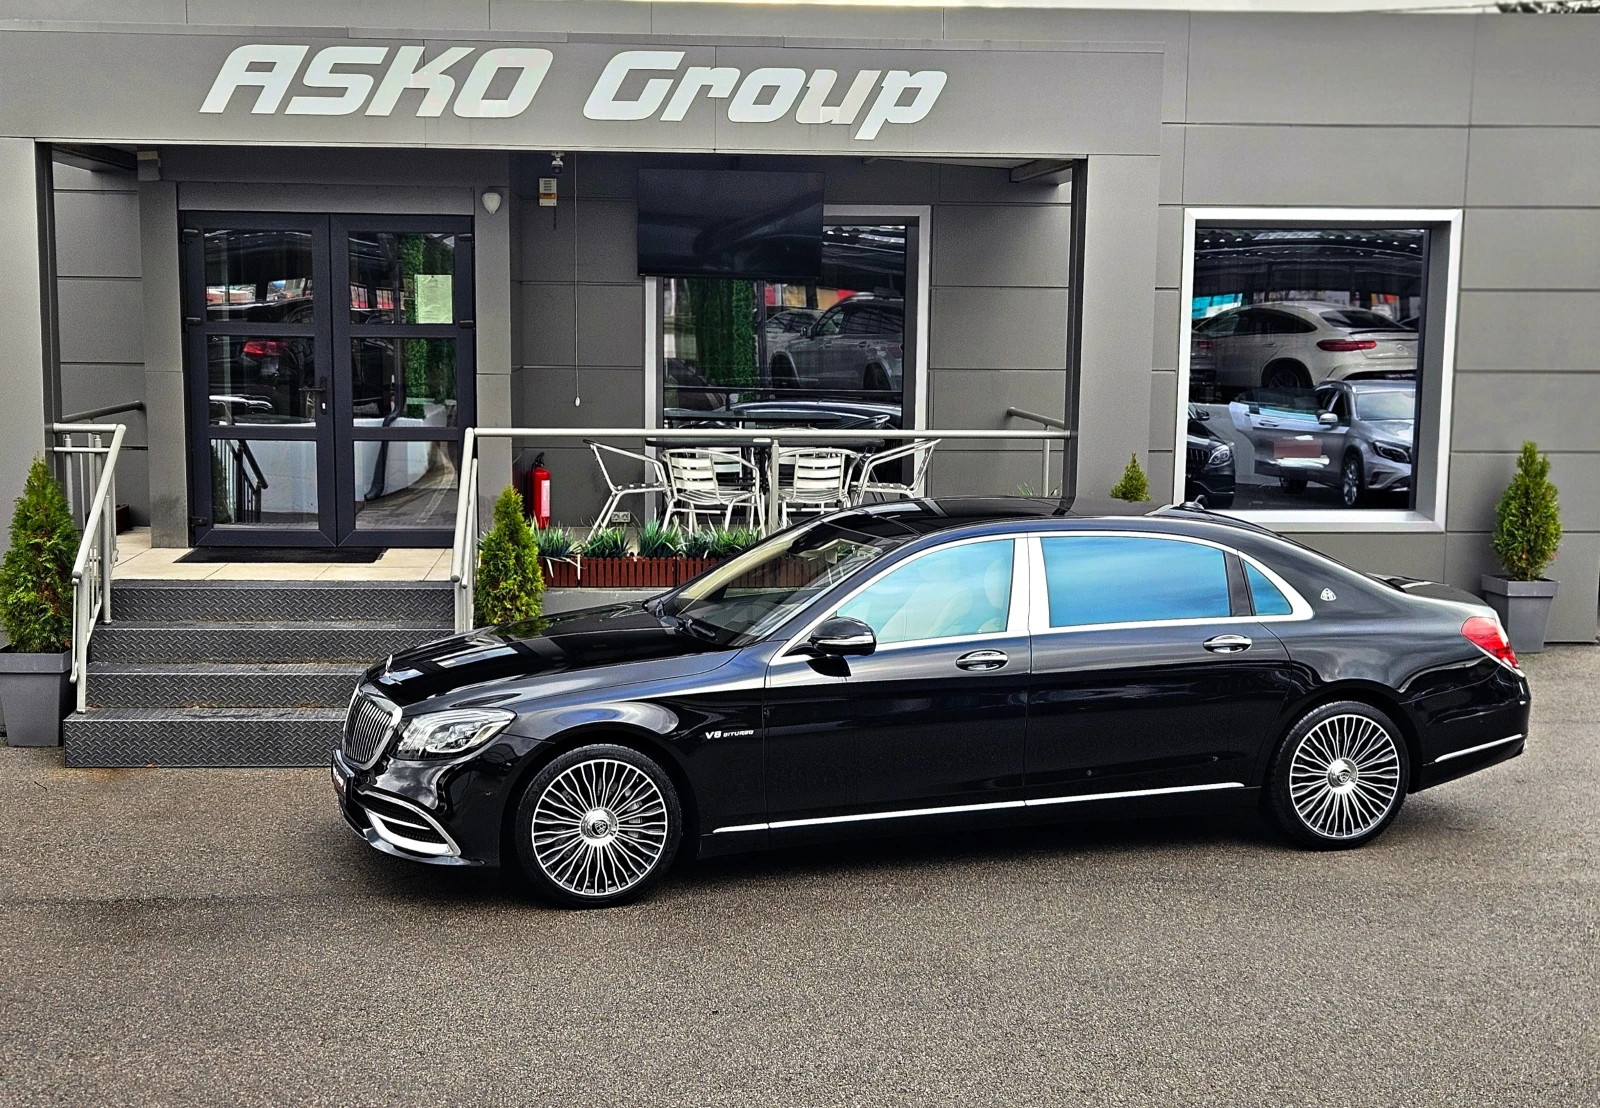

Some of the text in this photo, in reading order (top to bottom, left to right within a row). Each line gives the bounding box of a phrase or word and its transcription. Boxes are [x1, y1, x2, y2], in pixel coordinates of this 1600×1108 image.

[199, 44, 948, 141] ASKO Group
[705, 730, 722, 739] V8
